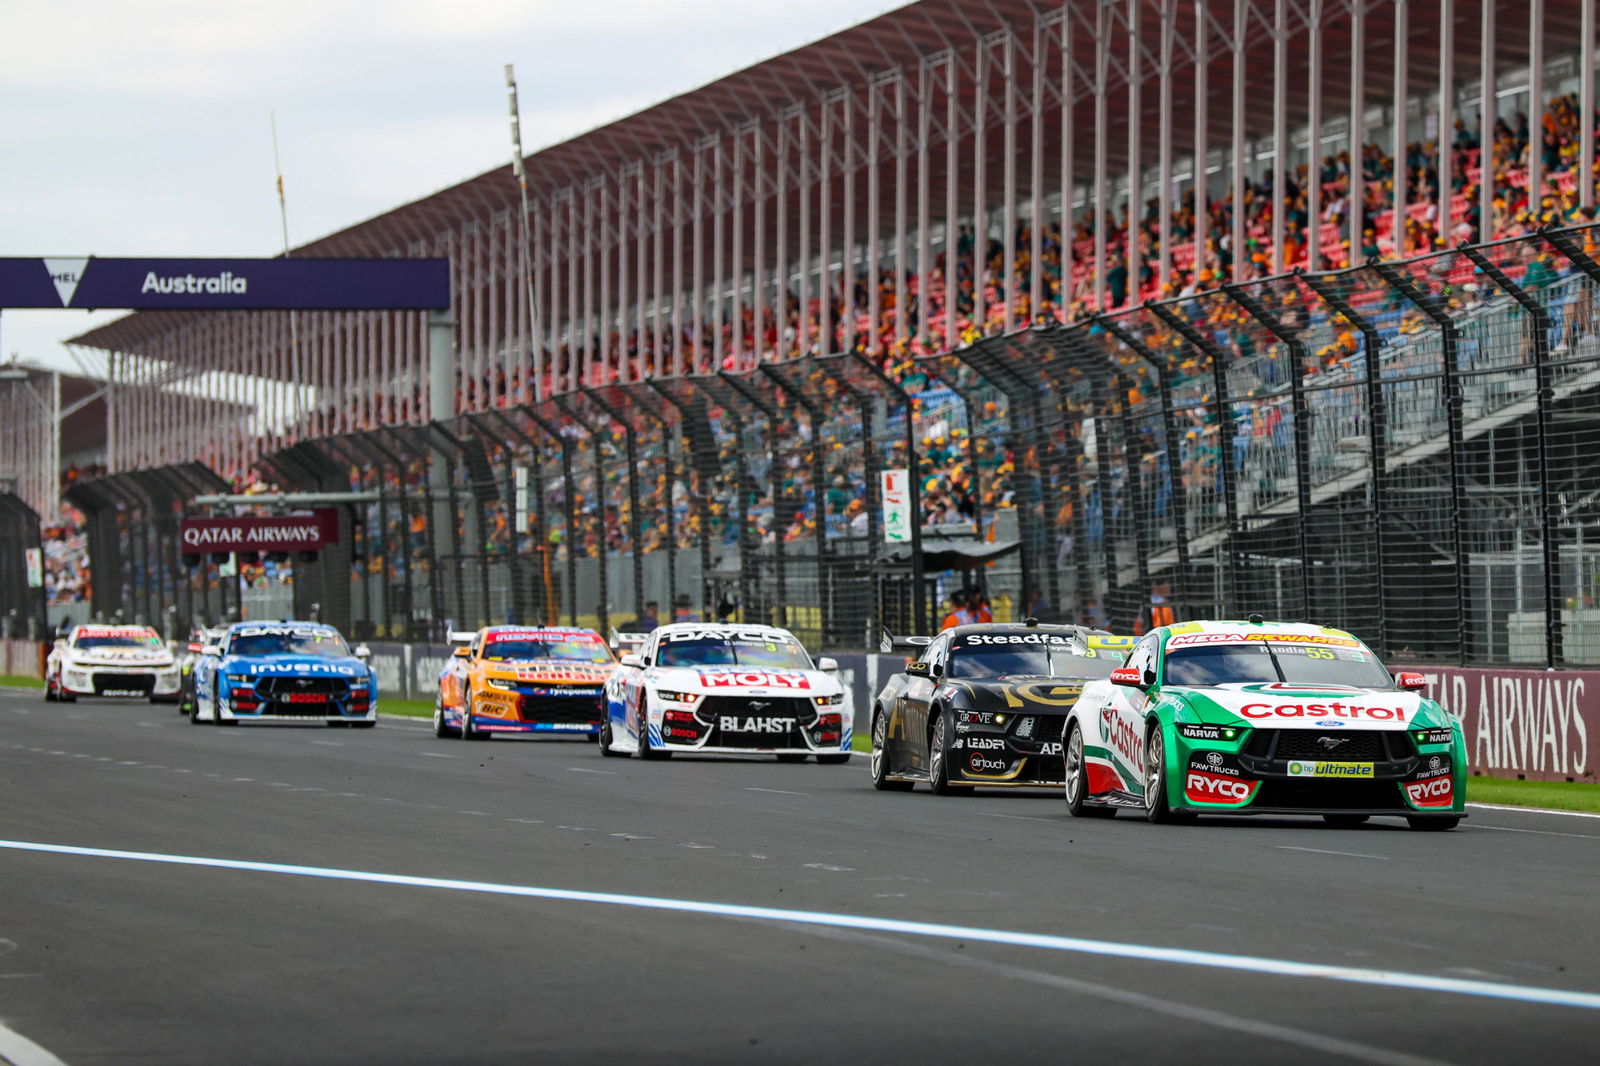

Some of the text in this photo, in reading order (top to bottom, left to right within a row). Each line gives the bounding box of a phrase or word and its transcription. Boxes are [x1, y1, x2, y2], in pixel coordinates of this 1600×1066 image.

[141, 271, 248, 294] Australia
[184, 525, 320, 546] QATAR AIRWAYS
[669, 630, 789, 644] DAYCO
[966, 634, 1074, 646] Steadfas
[1171, 633, 1361, 648] MEGA REWARDS
[765, 642, 777, 652] 3
[1305, 647, 1336, 660] 55
[704, 674, 807, 688] MOLY
[1110, 673, 1140, 681] RYCO
[960, 713, 991, 723] GROVE
[1240, 702, 1405, 721] Castrol
[720, 716, 796, 733] BLAHST
[1416, 673, 1588, 775] TAR AIRWAYS
[1109, 708, 1144, 773] Castro
[1183, 728, 1219, 739] NARVA
[1429, 733, 1452, 743] NARV
[967, 738, 1005, 750] LEADER
[1040, 743, 1062, 755] AP
[971, 757, 1006, 769] airtouch
[1191, 761, 1239, 776] FAW TRUCKS
[1304, 763, 1371, 775] bp ultimate
[1187, 774, 1250, 799] RYCO
[1407, 777, 1451, 800] RYCO
